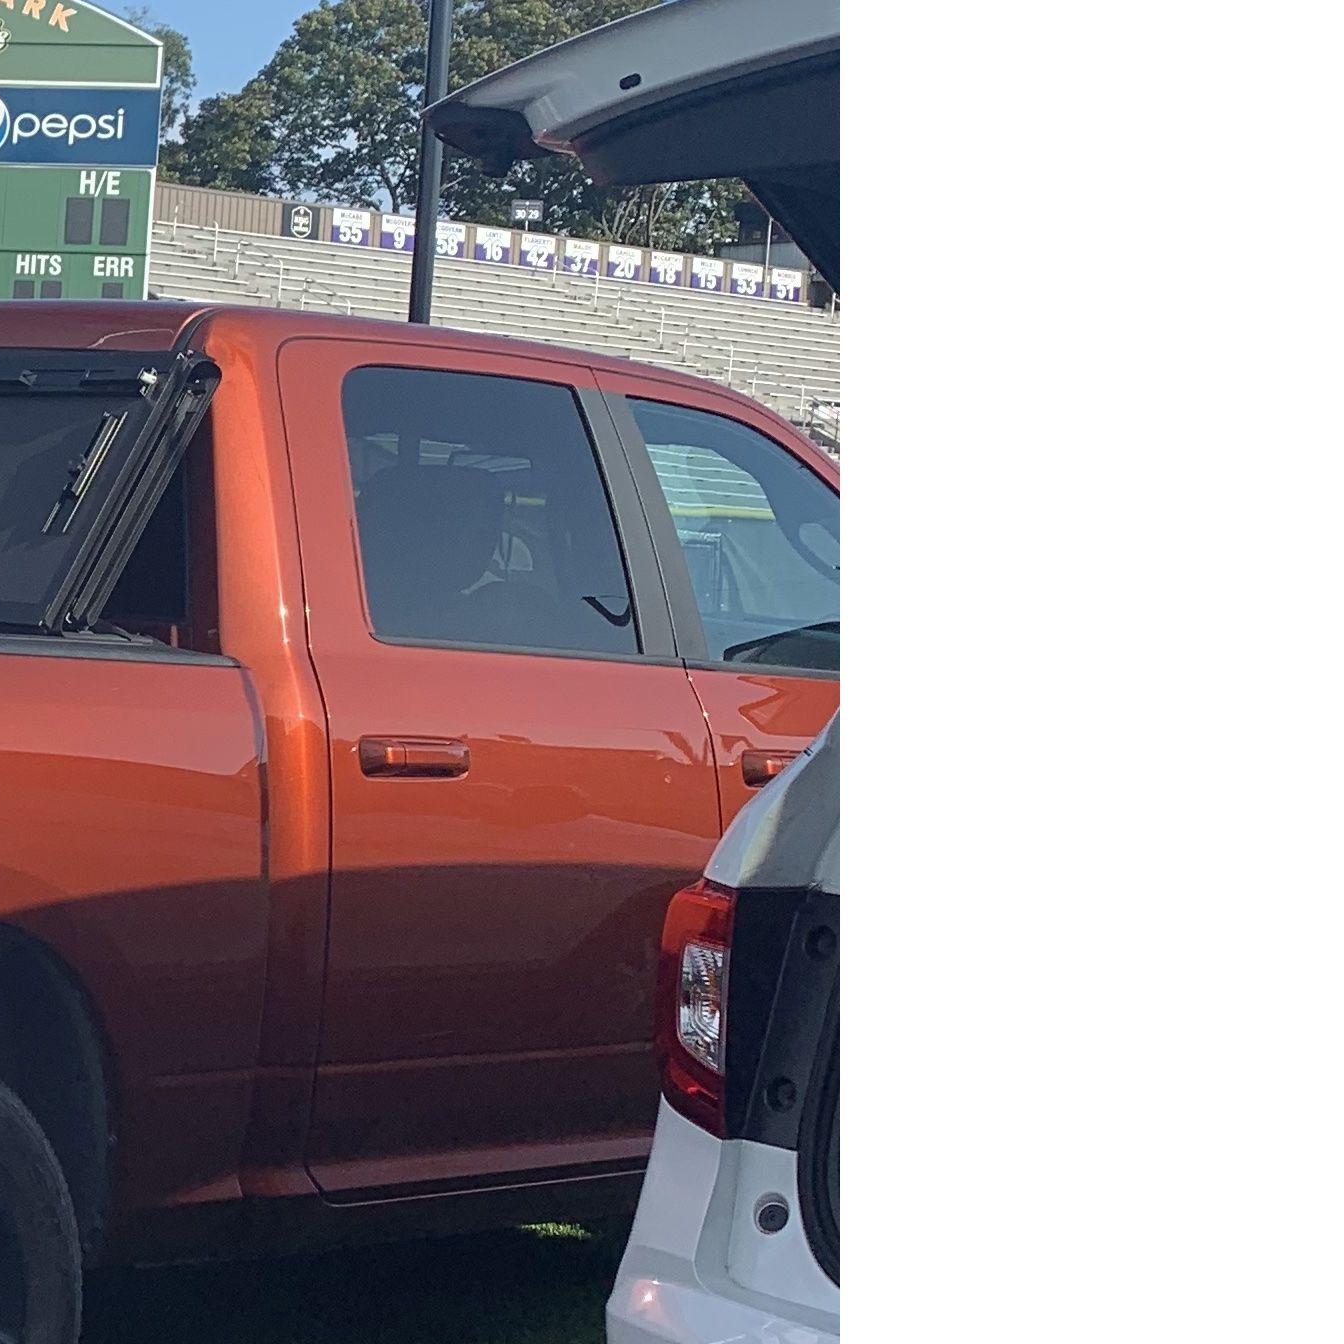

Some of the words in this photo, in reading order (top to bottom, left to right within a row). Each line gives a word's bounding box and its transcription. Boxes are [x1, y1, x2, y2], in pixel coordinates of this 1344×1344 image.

[12, 108, 125, 146] pepsi
[80, 170, 121, 197] H/E
[338, 223, 362, 244] 55
[393, 228, 406, 249] 9
[436, 233, 459, 256] 58
[483, 239, 503, 261] 16
[15, 254, 62, 276] HITS
[93, 256, 134, 278] ERR
[526, 245, 549, 267] 42
[570, 253, 592, 273] 37
[613, 258, 635, 278] 20
[657, 267, 676, 285] 18
[698, 272, 716, 289] 15
[776, 282, 794, 300] 51
